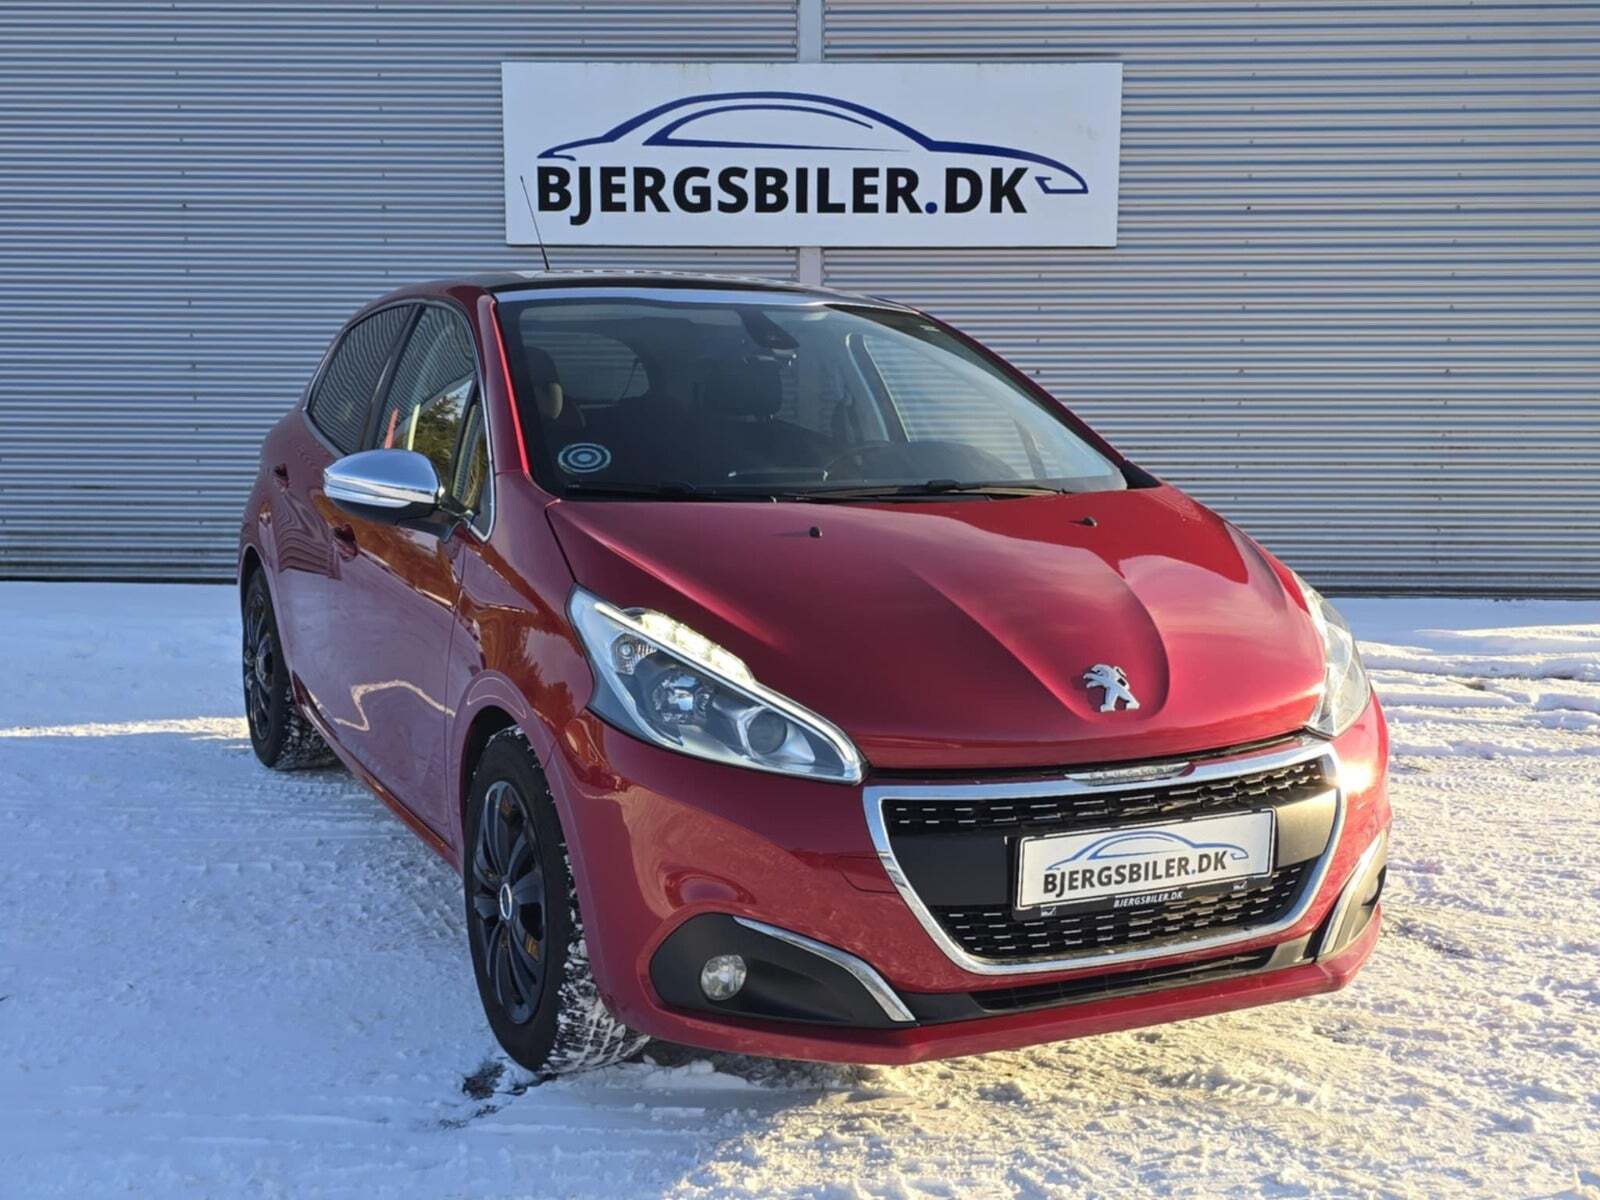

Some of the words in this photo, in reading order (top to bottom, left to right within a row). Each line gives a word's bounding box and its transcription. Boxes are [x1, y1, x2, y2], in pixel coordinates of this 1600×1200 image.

[537, 166, 1027, 226] BJERGSBILER.DK
[1043, 850, 1227, 897] BJERGSBILER.DK
[1113, 891, 1184, 908] BJERGSBILER.DK
